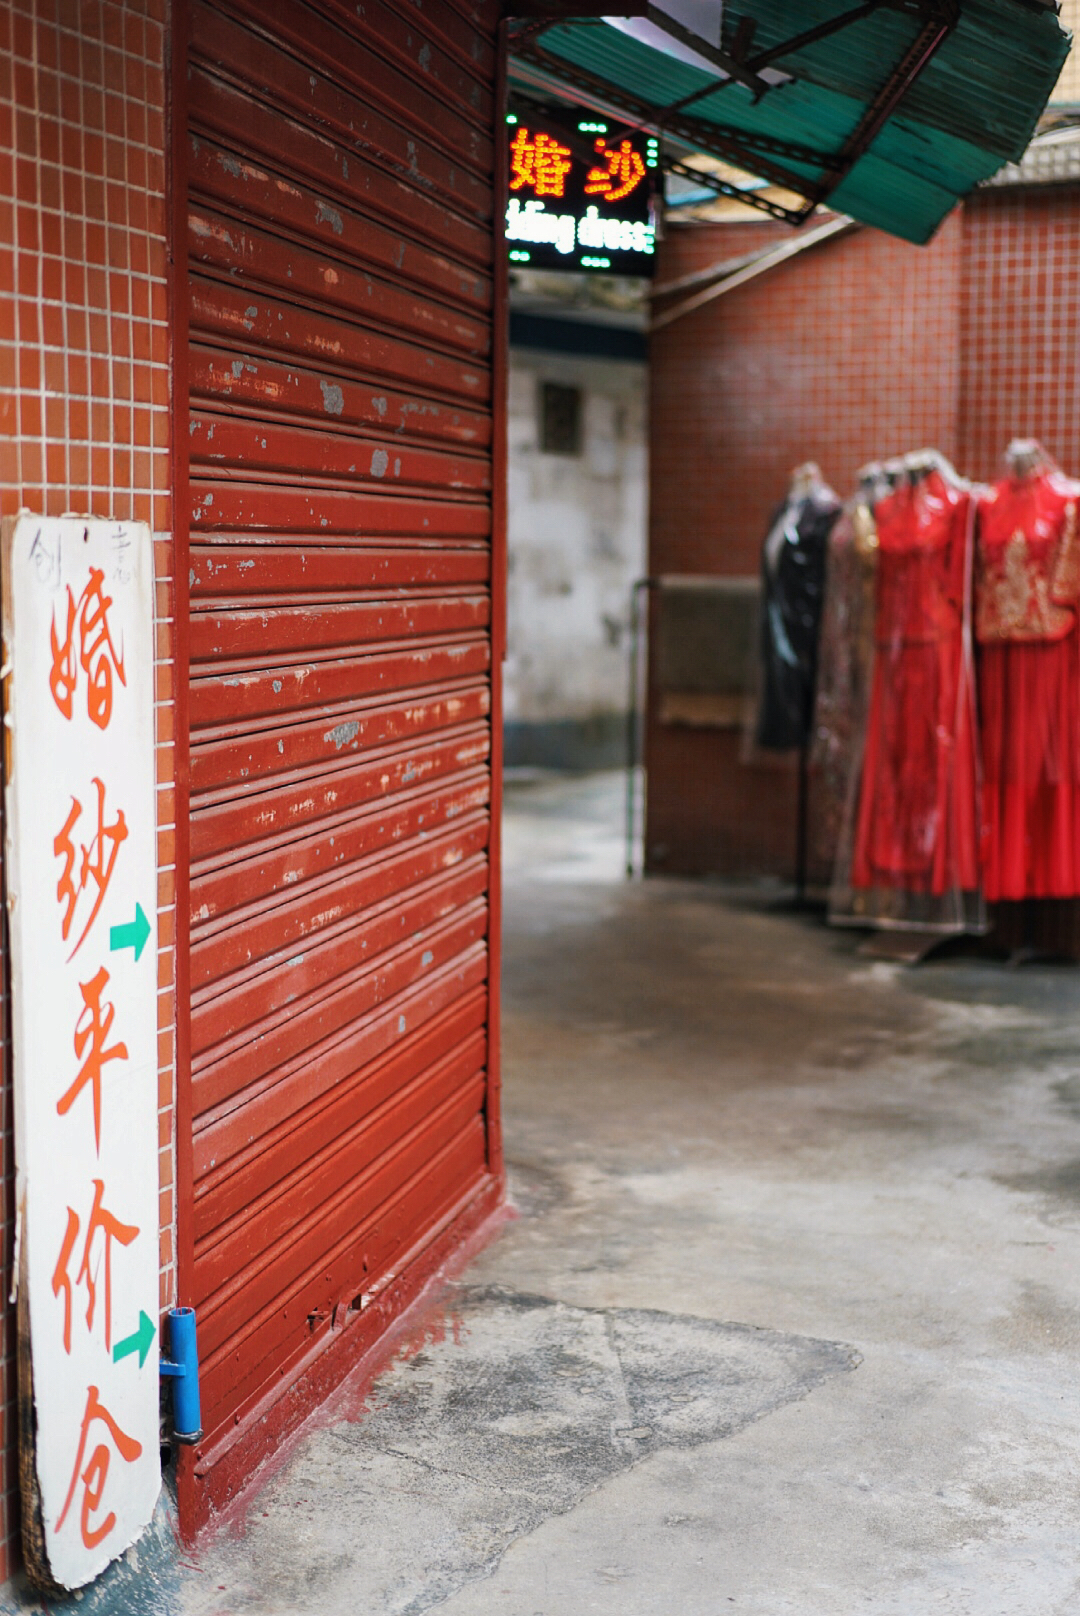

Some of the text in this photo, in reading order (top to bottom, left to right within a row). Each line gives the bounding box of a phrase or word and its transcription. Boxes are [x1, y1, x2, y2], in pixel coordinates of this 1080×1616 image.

[509, 127, 646, 201] 婚纱
[49, 565, 143, 1550] 婚纱平价仓
